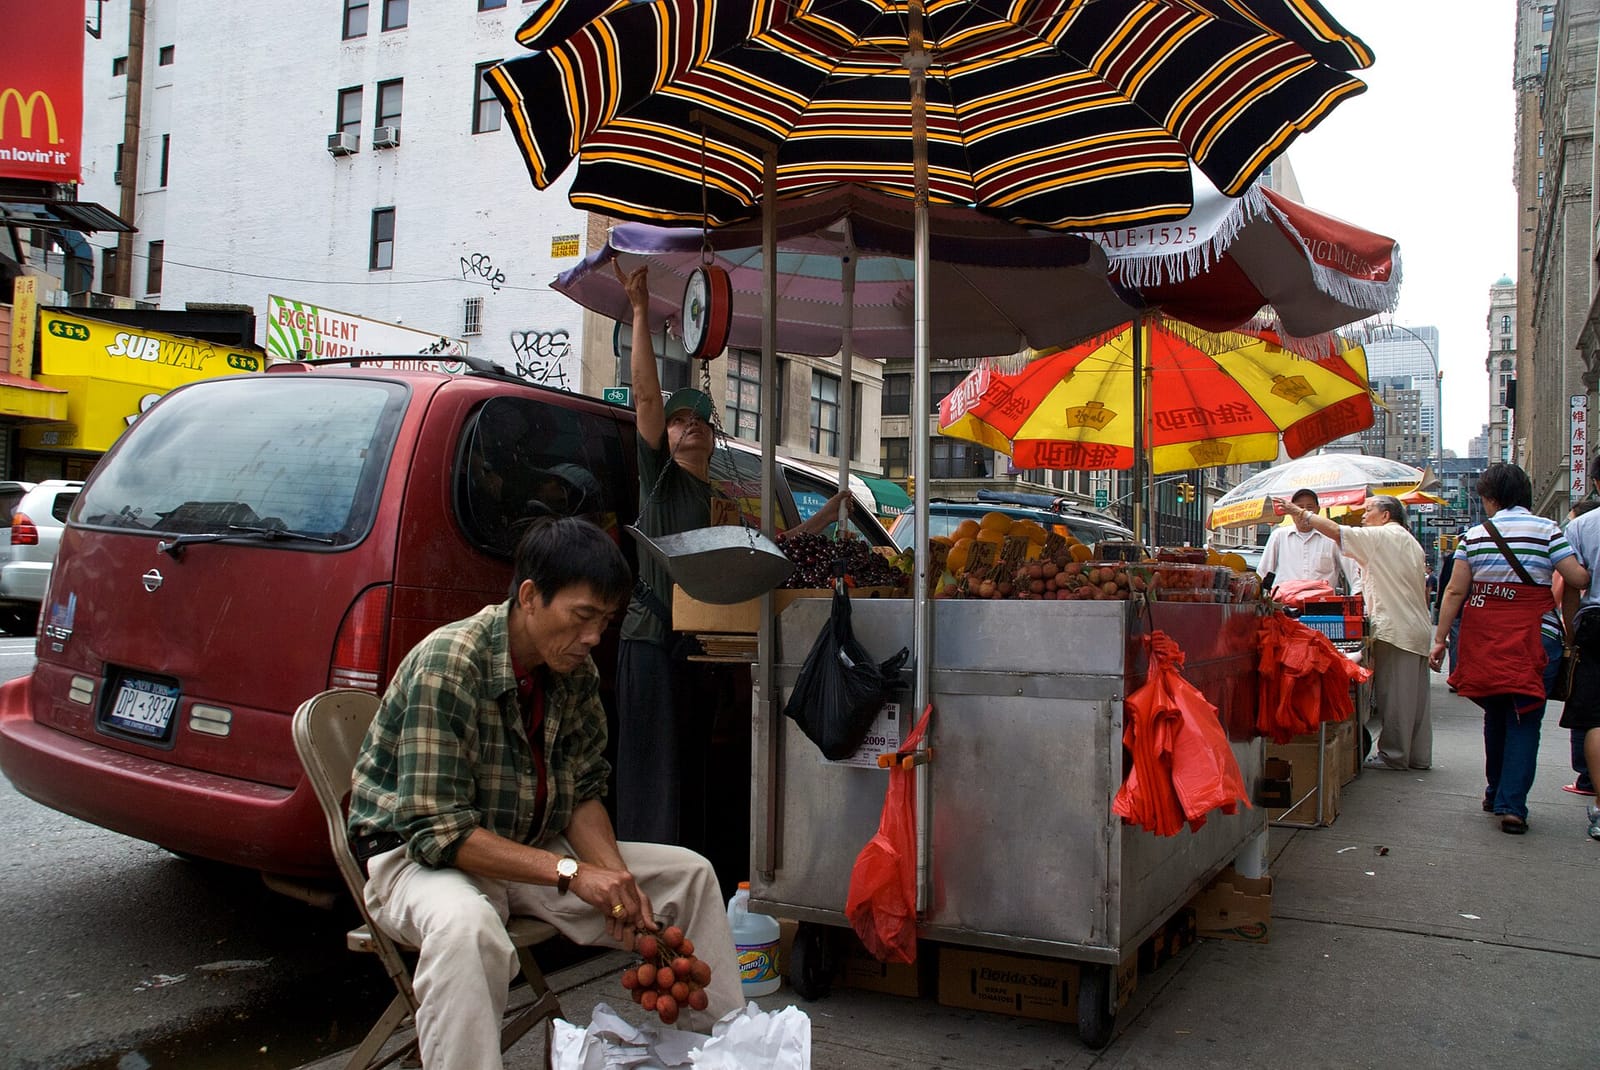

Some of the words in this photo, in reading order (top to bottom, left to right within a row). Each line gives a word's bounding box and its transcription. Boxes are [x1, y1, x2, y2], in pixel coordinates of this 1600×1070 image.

[54, 150, 66, 165] it
[1147, 225, 1198, 245] 1525
[278, 306, 359, 343] EXCELLENT
[105, 331, 215, 370] SUBWAY
[1481, 583, 1517, 600] JEANS
[1470, 594, 1486, 608] 85
[116, 689, 139, 717] DPL
[142, 695, 175, 724] 3934
[863, 736, 886, 746] 2009
